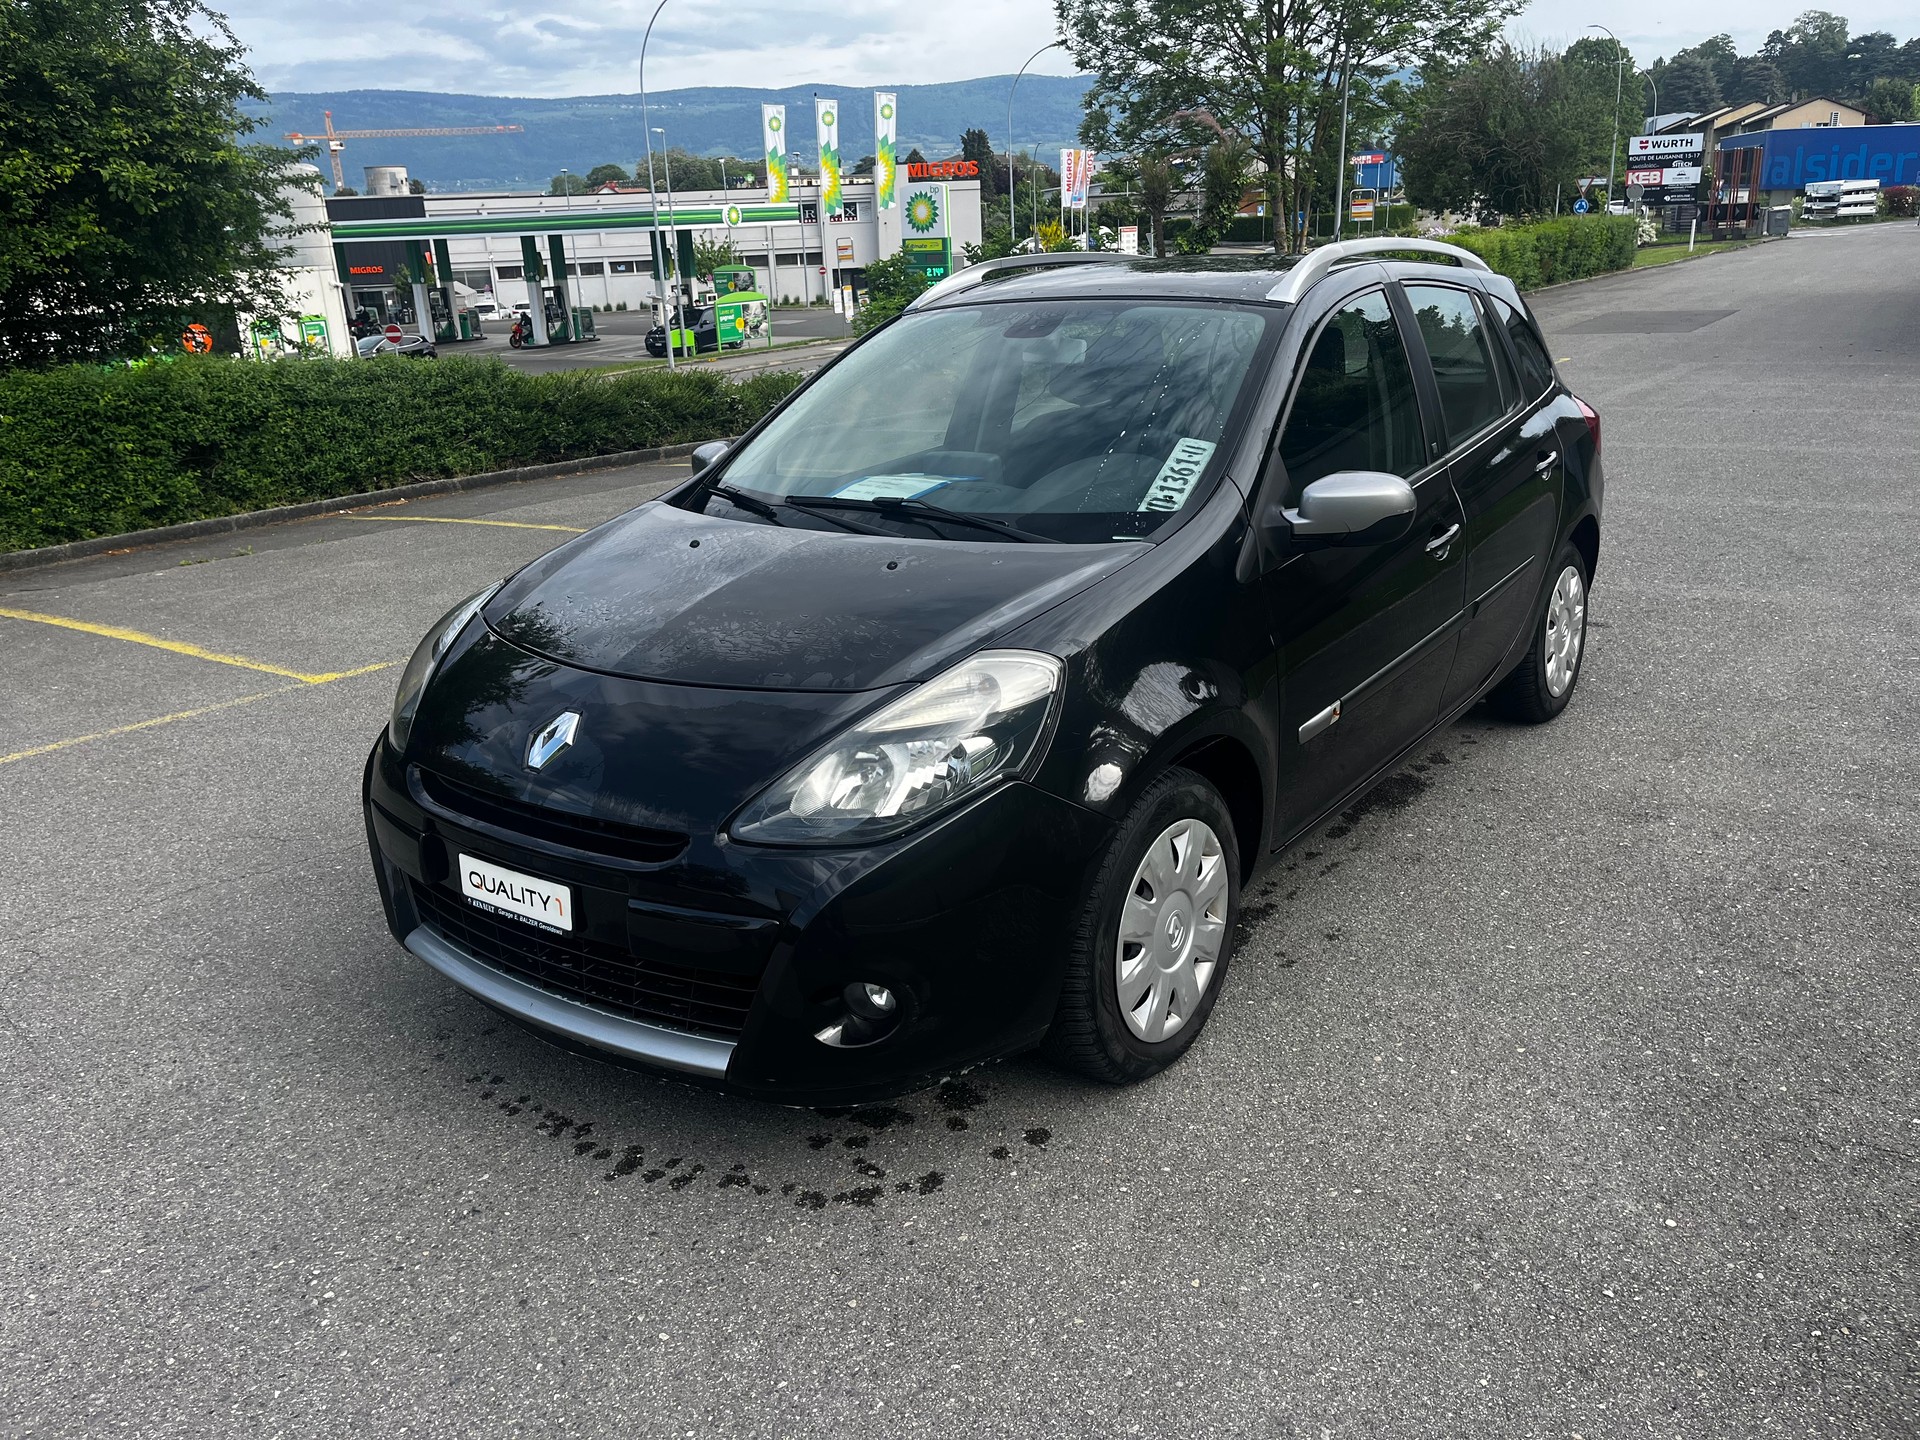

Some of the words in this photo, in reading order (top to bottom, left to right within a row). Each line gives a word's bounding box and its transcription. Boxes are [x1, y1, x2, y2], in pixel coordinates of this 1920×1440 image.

[1651, 138, 1694, 149] WÜRTH
[907, 160, 979, 178] MIGROS
[1628, 172, 1660, 185] KEB
[930, 186, 939, 195] bp
[350, 265, 384, 274] MIGROS
[469, 871, 551, 911] QUALITY
[555, 897, 563, 917] 1
[472, 900, 495, 913] RENAULT
[497, 908, 514, 919] Garage
[519, 915, 538, 927] BALZER
